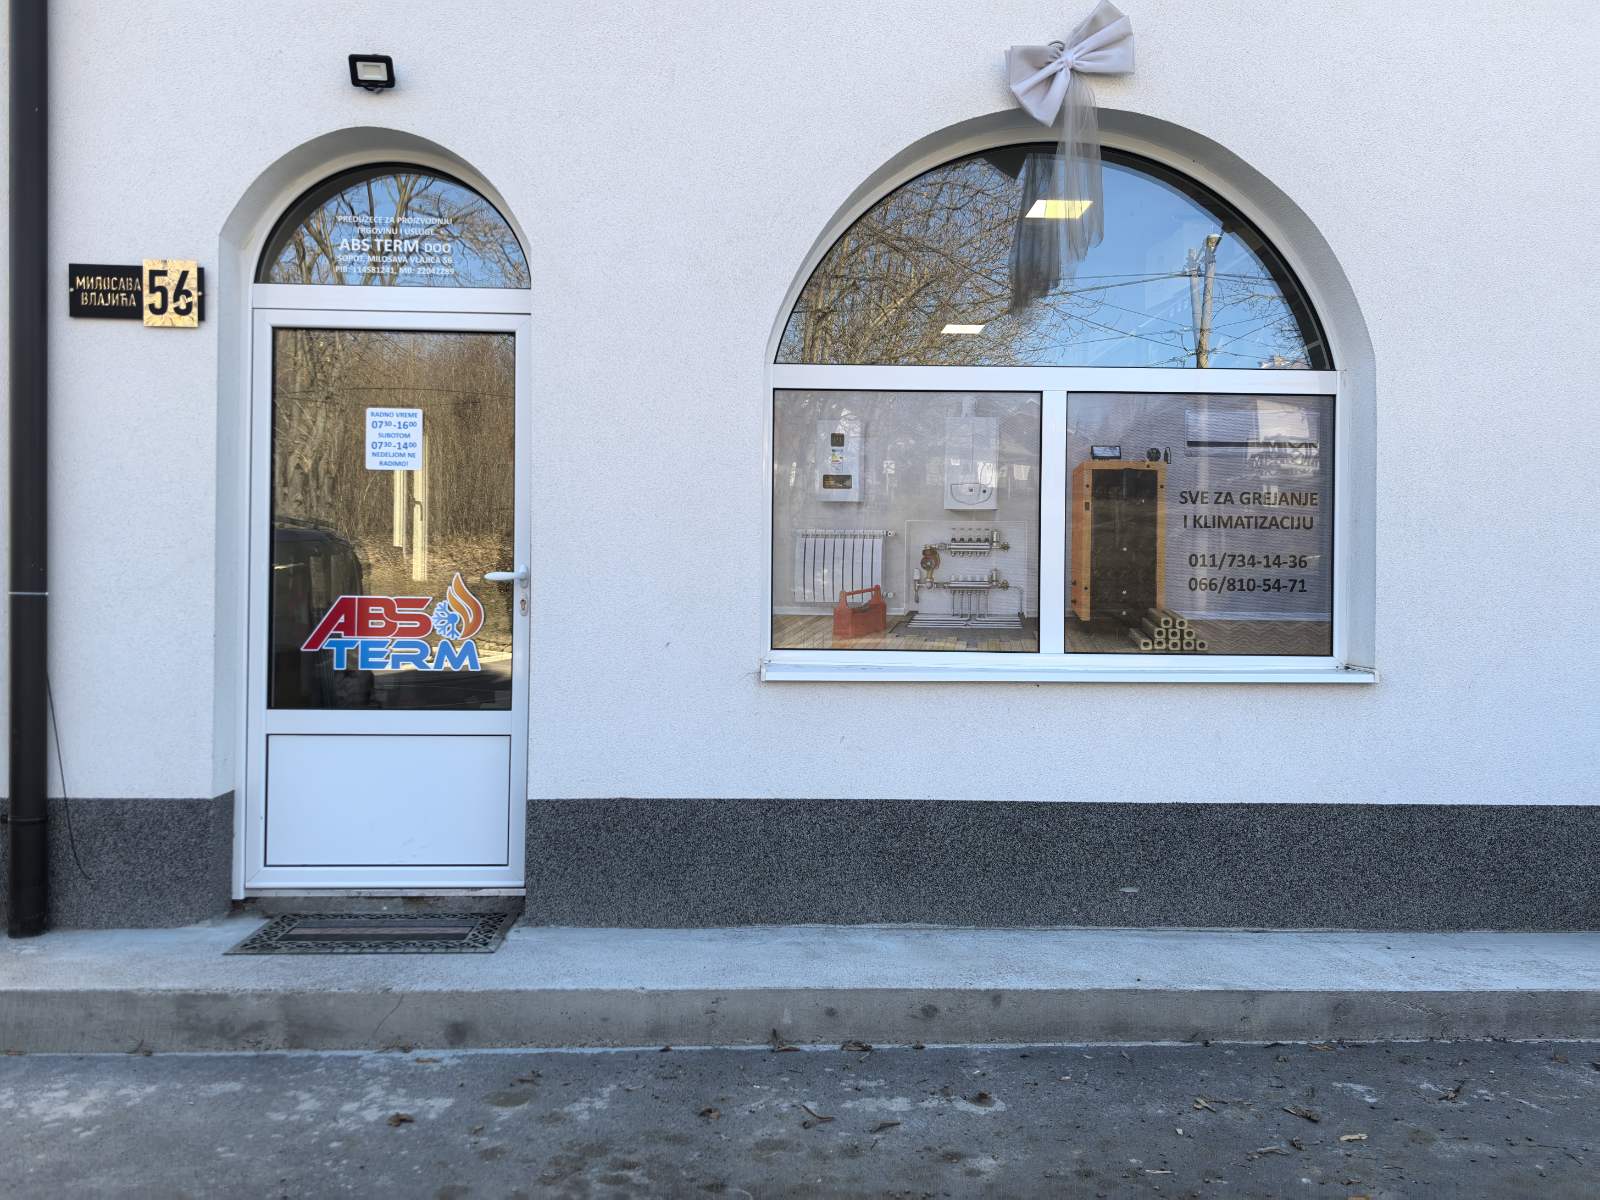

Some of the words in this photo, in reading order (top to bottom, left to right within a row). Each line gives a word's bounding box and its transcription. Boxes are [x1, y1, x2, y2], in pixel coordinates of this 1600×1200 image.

[386, 216, 395, 224] ZA
[397, 216, 453, 225] PROIZVODNJU
[358, 227, 398, 235] TRGOVINU
[405, 227, 435, 236] USLUGE
[338, 238, 370, 252] ABS
[375, 238, 420, 253] TERM
[424, 243, 452, 253] DOO
[367, 255, 409, 264] MILOSAVA
[76, 275, 142, 291] МИЛОСАВА
[81, 291, 137, 307] ВЛАЈИЋА
[147, 269, 194, 317] 56
[378, 460, 409, 468] RADIMO!
[1178, 490, 1209, 505] SVE
[1213, 490, 1235, 505] ZA
[1239, 491, 1319, 506] GREJANJE
[1183, 515, 1188, 529] I
[1192, 515, 1314, 530] KLIMATIZACIJU
[1188, 552, 1309, 571] 011/734-14-36
[1188, 576, 1309, 594] 066/810-54-71
[300, 595, 433, 651] ABS
[322, 637, 482, 672] TERM
